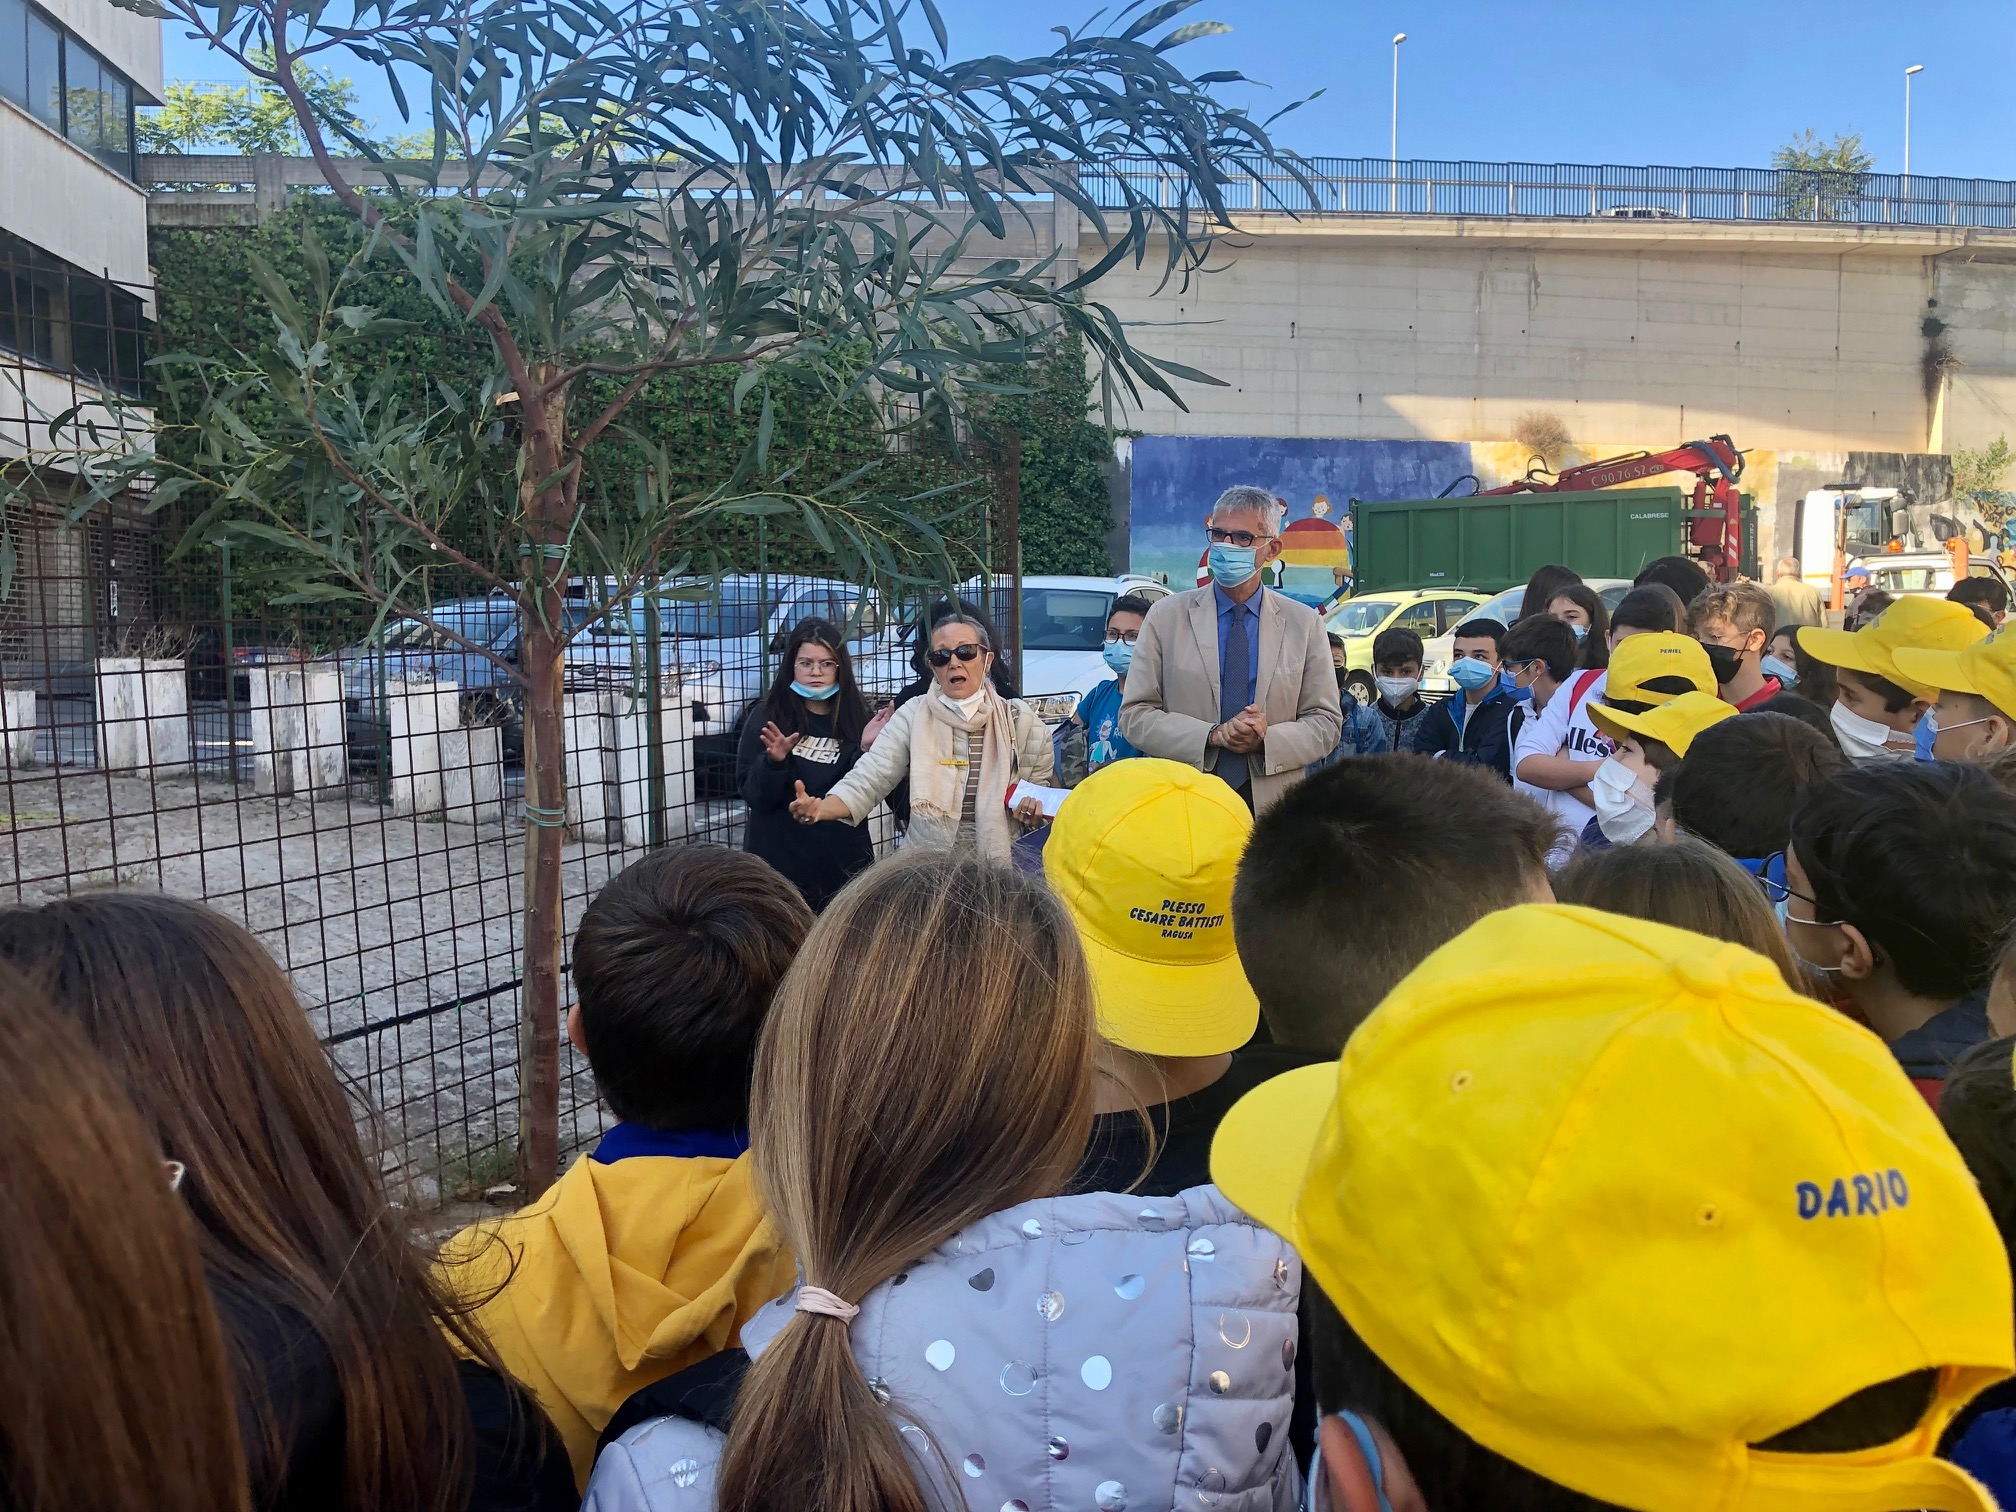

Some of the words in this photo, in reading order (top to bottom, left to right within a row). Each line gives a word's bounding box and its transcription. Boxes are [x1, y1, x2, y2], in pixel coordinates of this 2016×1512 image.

[1630, 512, 1669, 520] CALABRESE
[1569, 726, 1611, 758] lles
[1161, 899, 1206, 915] PLESSO
[1129, 907, 1177, 927] CESARE
[1178, 914, 1225, 929] BATTISTI
[1161, 929, 1194, 940] RAGUSA
[1796, 1168, 1908, 1220] DARIO
